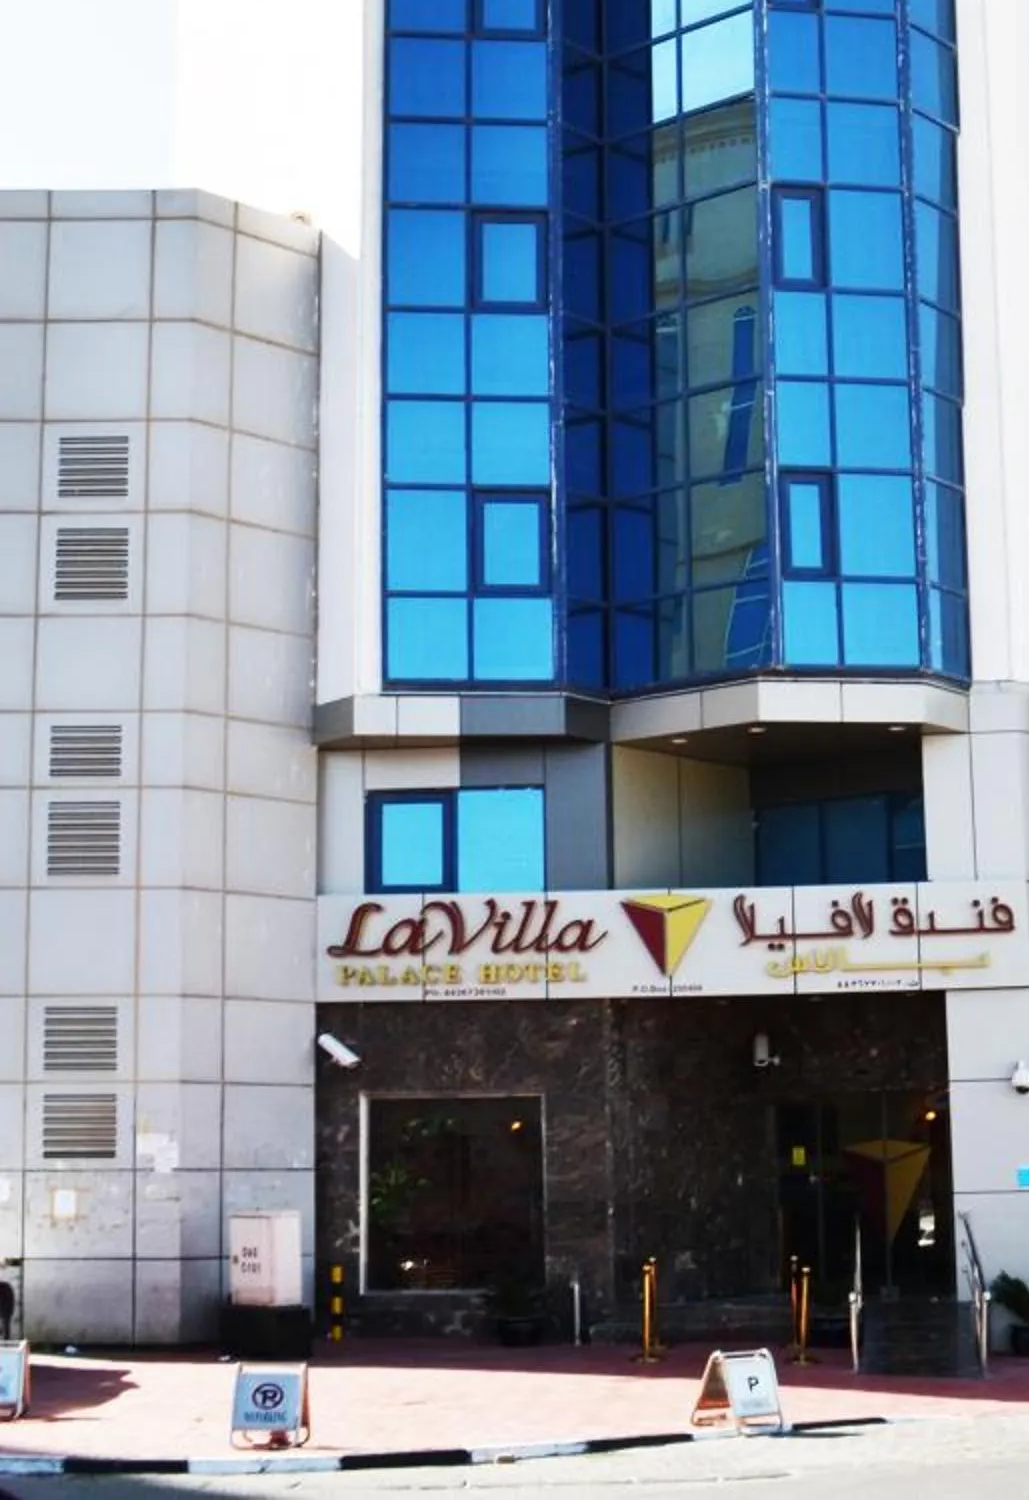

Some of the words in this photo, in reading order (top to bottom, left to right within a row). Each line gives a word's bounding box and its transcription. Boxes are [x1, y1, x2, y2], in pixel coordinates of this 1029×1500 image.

[733, 891, 874, 951] لافيلا
[889, 897, 1015, 937] فندق
[337, 964, 462, 986] PALACE
[478, 961, 588, 984] HOTEL
